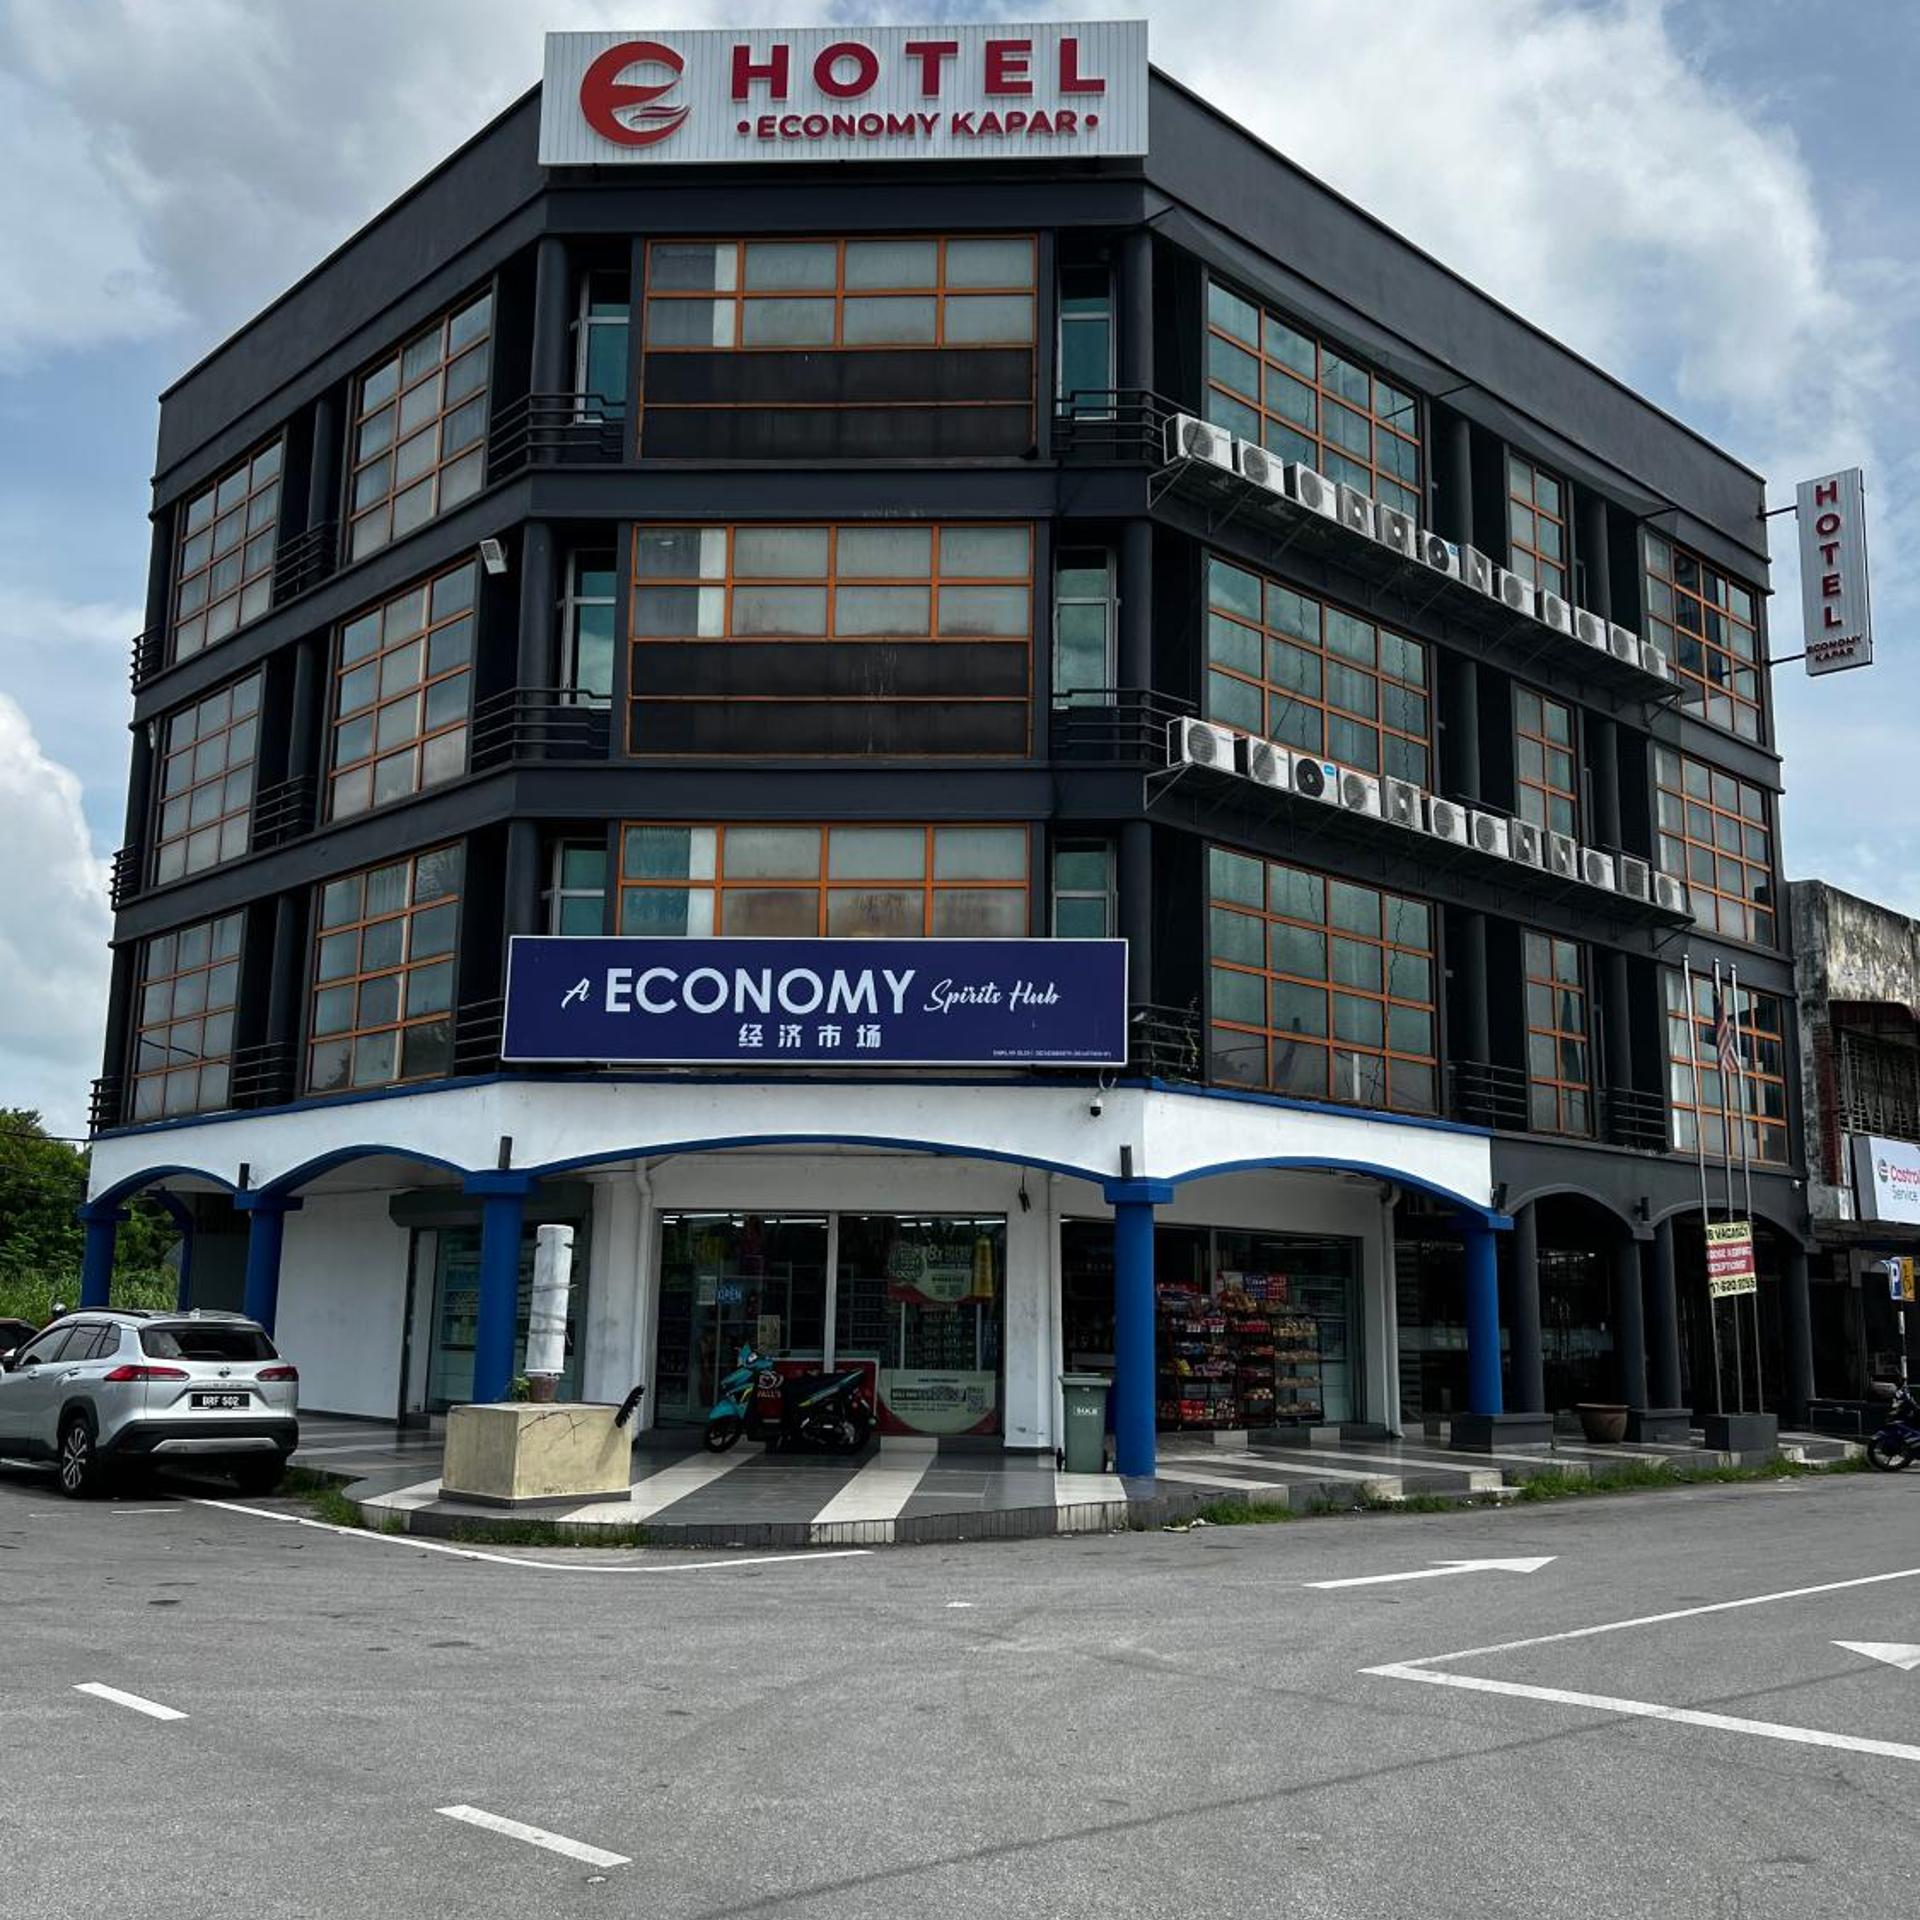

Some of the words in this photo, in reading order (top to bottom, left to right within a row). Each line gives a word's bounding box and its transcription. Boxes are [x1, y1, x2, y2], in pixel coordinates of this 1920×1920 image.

[731, 38, 1105, 101] HOTEL
[756, 112, 940, 142] ECONOMY
[951, 109, 1077, 139] KAPAR
[1815, 479, 1842, 629] HOTEL
[1806, 634, 1862, 655] ECONOMY
[1815, 646, 1855, 663] KAPAR
[561, 978, 590, 1009] A
[605, 967, 916, 1015] ECONOMY
[922, 977, 1002, 1014] Spirits
[1007, 976, 1062, 1006] Hub
[738, 1024, 882, 1049] 经济市场
